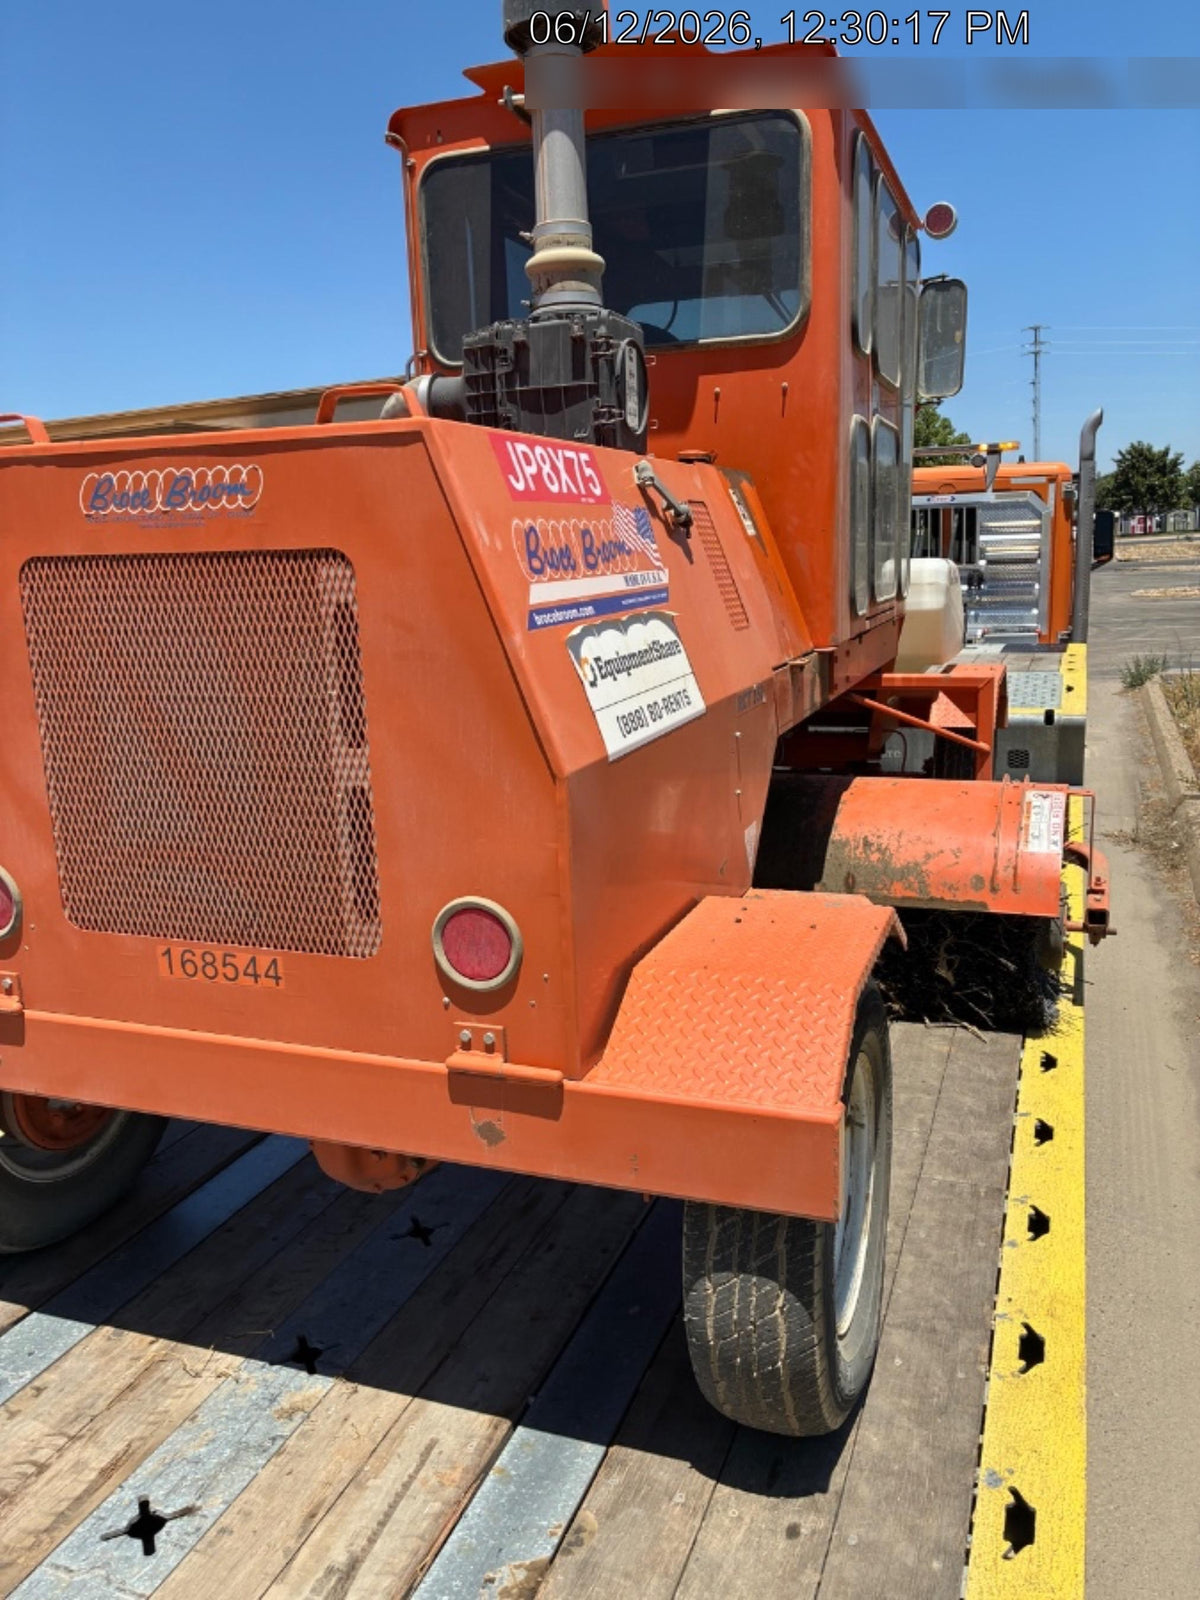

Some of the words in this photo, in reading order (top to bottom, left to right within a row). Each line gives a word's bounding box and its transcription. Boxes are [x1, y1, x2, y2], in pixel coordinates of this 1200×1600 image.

[505, 440, 602, 496] JP8X75
[89, 475, 150, 511] Broce
[166, 475, 254, 507] Broom
[593, 639, 682, 681] EquipmentShare
[616, 705, 649, 738] (888)
[646, 688, 692, 723] 80-RENTS
[161, 946, 283, 987] 168544
